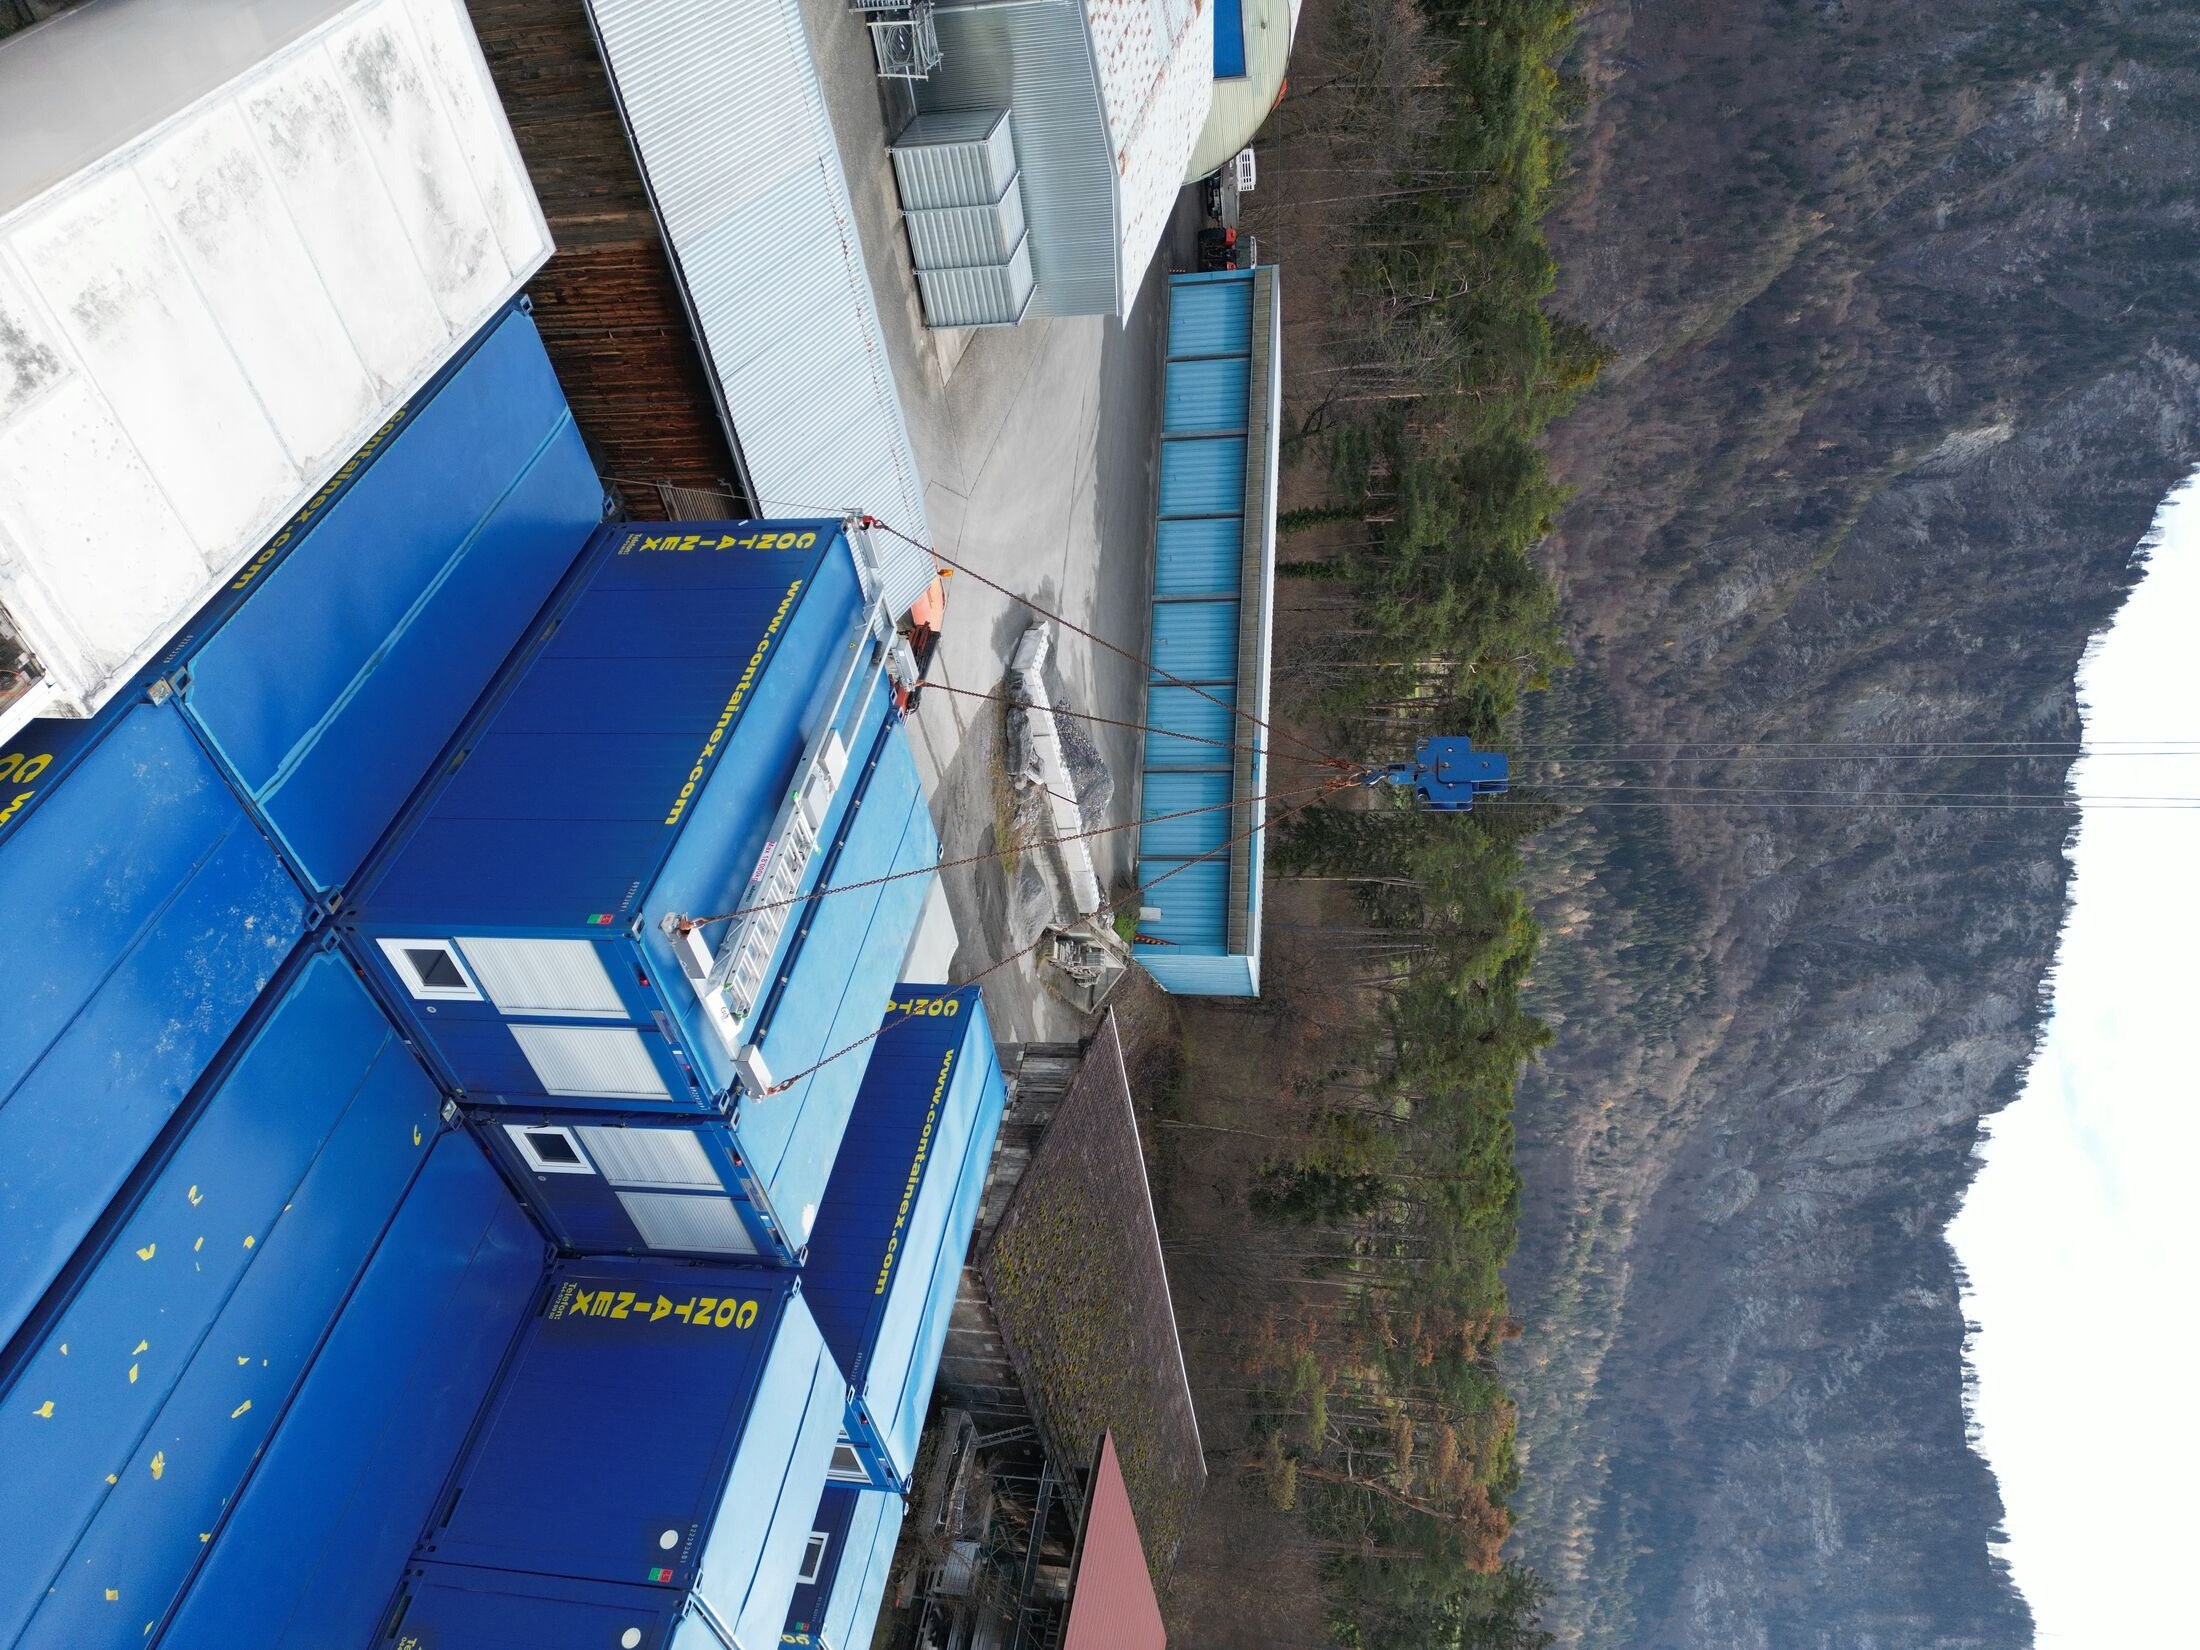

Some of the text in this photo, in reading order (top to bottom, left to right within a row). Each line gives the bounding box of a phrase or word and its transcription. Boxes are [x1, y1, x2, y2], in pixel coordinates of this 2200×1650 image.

[639, 532, 817, 551] CONTAINEX
[665, 579, 803, 825] www.containex.com
[873, 1048, 954, 1295] www.containex.com
[554, 1282, 578, 1320] Telefon:
[568, 1288, 759, 1330] CONTAINEX
